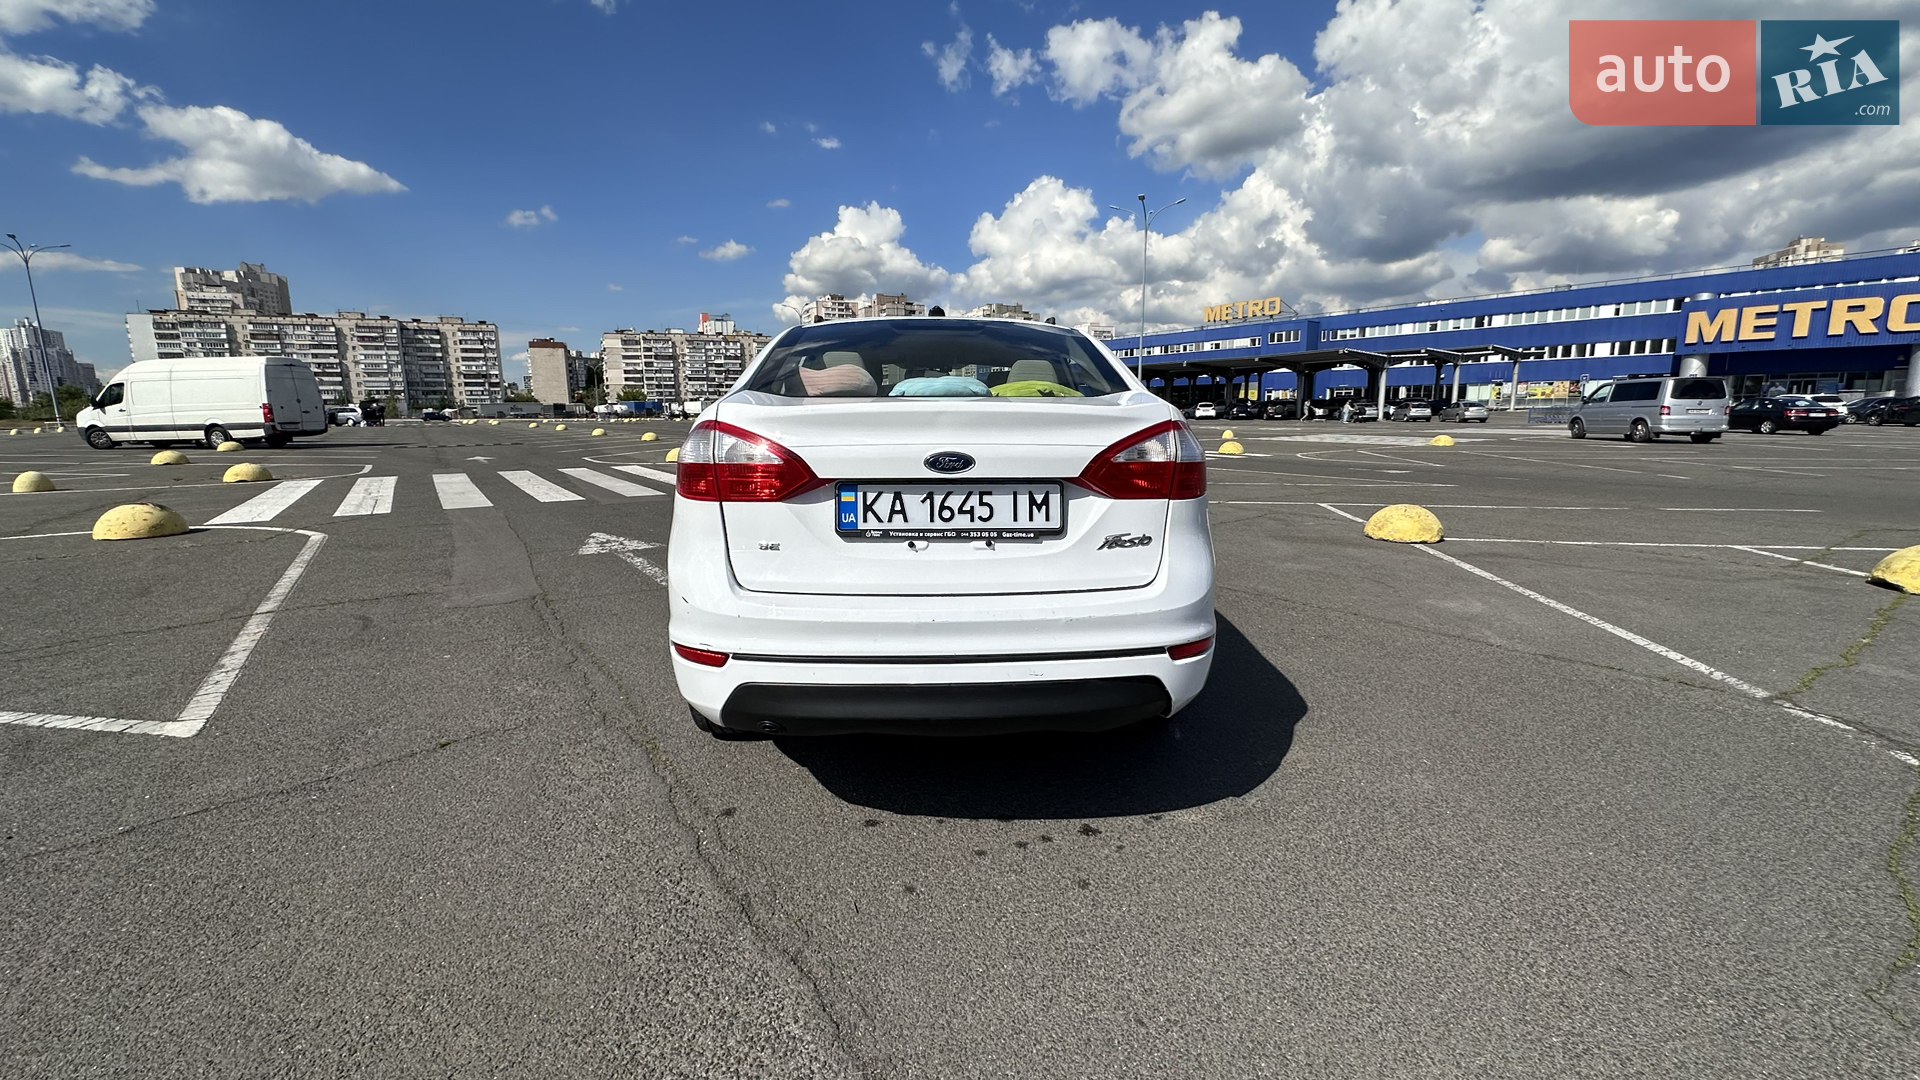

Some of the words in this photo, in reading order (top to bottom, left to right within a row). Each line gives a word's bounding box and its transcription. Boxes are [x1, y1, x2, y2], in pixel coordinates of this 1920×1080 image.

[1203, 296, 1282, 323] METRO
[1684, 293, 1920, 345] METRO
[935, 456, 964, 469] Ford
[841, 513, 856, 523] UA
[862, 491, 909, 523] KA
[920, 491, 994, 523] 1645
[1012, 490, 1050, 522] IM
